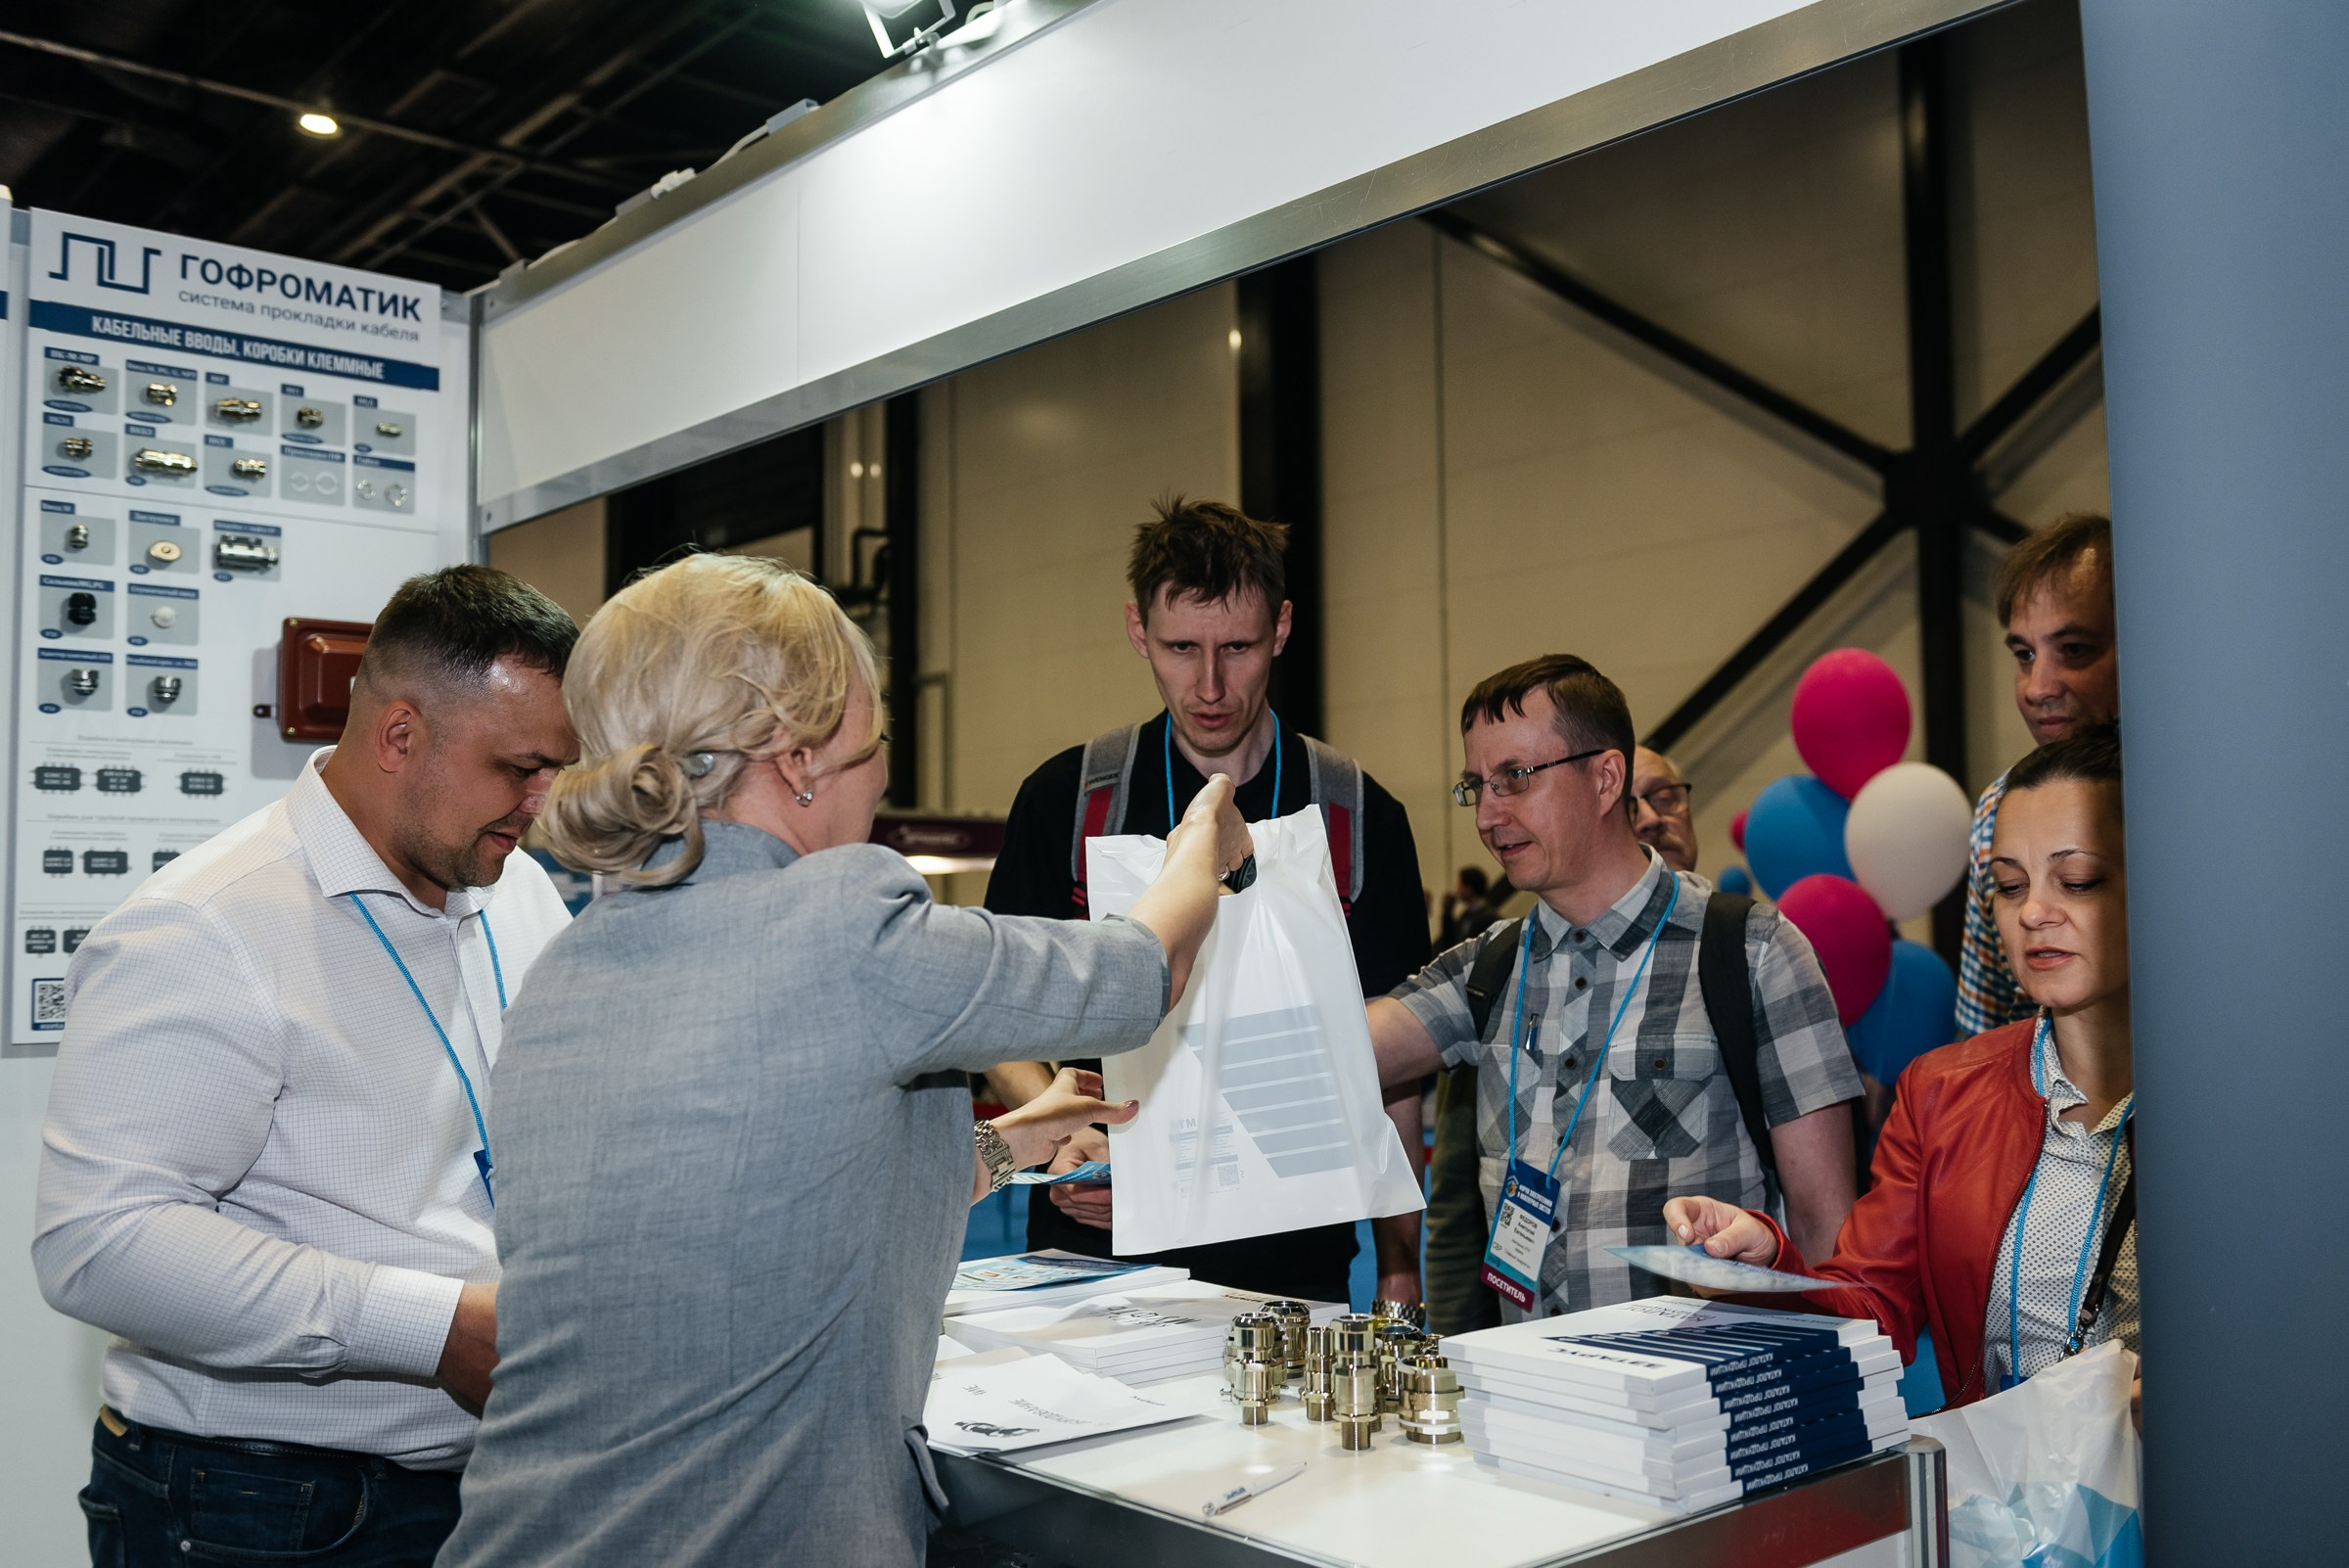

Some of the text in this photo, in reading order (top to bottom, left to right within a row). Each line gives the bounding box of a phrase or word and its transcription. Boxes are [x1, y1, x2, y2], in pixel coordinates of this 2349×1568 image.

[180, 254, 422, 322] ГОФРОМАТИК
[178, 290, 420, 343] система прокладки кабеля
[92, 315, 182, 346] КАБЕЛЬНЫЕ
[243, 341, 305, 366] КОРОБКИ
[307, 349, 385, 380] КЛЕММНЫЕ
[1487, 1272, 1526, 1303] ПОСЕТИТЕЛЬ
[1749, 1352, 1773, 1367] КАТАЛОГ
[1756, 1368, 1782, 1384] КАТАЛОГ
[1764, 1385, 1790, 1400] КАТАЛОГ
[1773, 1398, 1798, 1412] КАТАЛОГ
[1769, 1416, 1794, 1431] КАТАЛОГ
[1770, 1434, 1796, 1450] КАТАЛОГ
[1774, 1451, 1800, 1466] КАТАЛОГ
[1783, 1463, 1809, 1480] КАТАЛОГ
